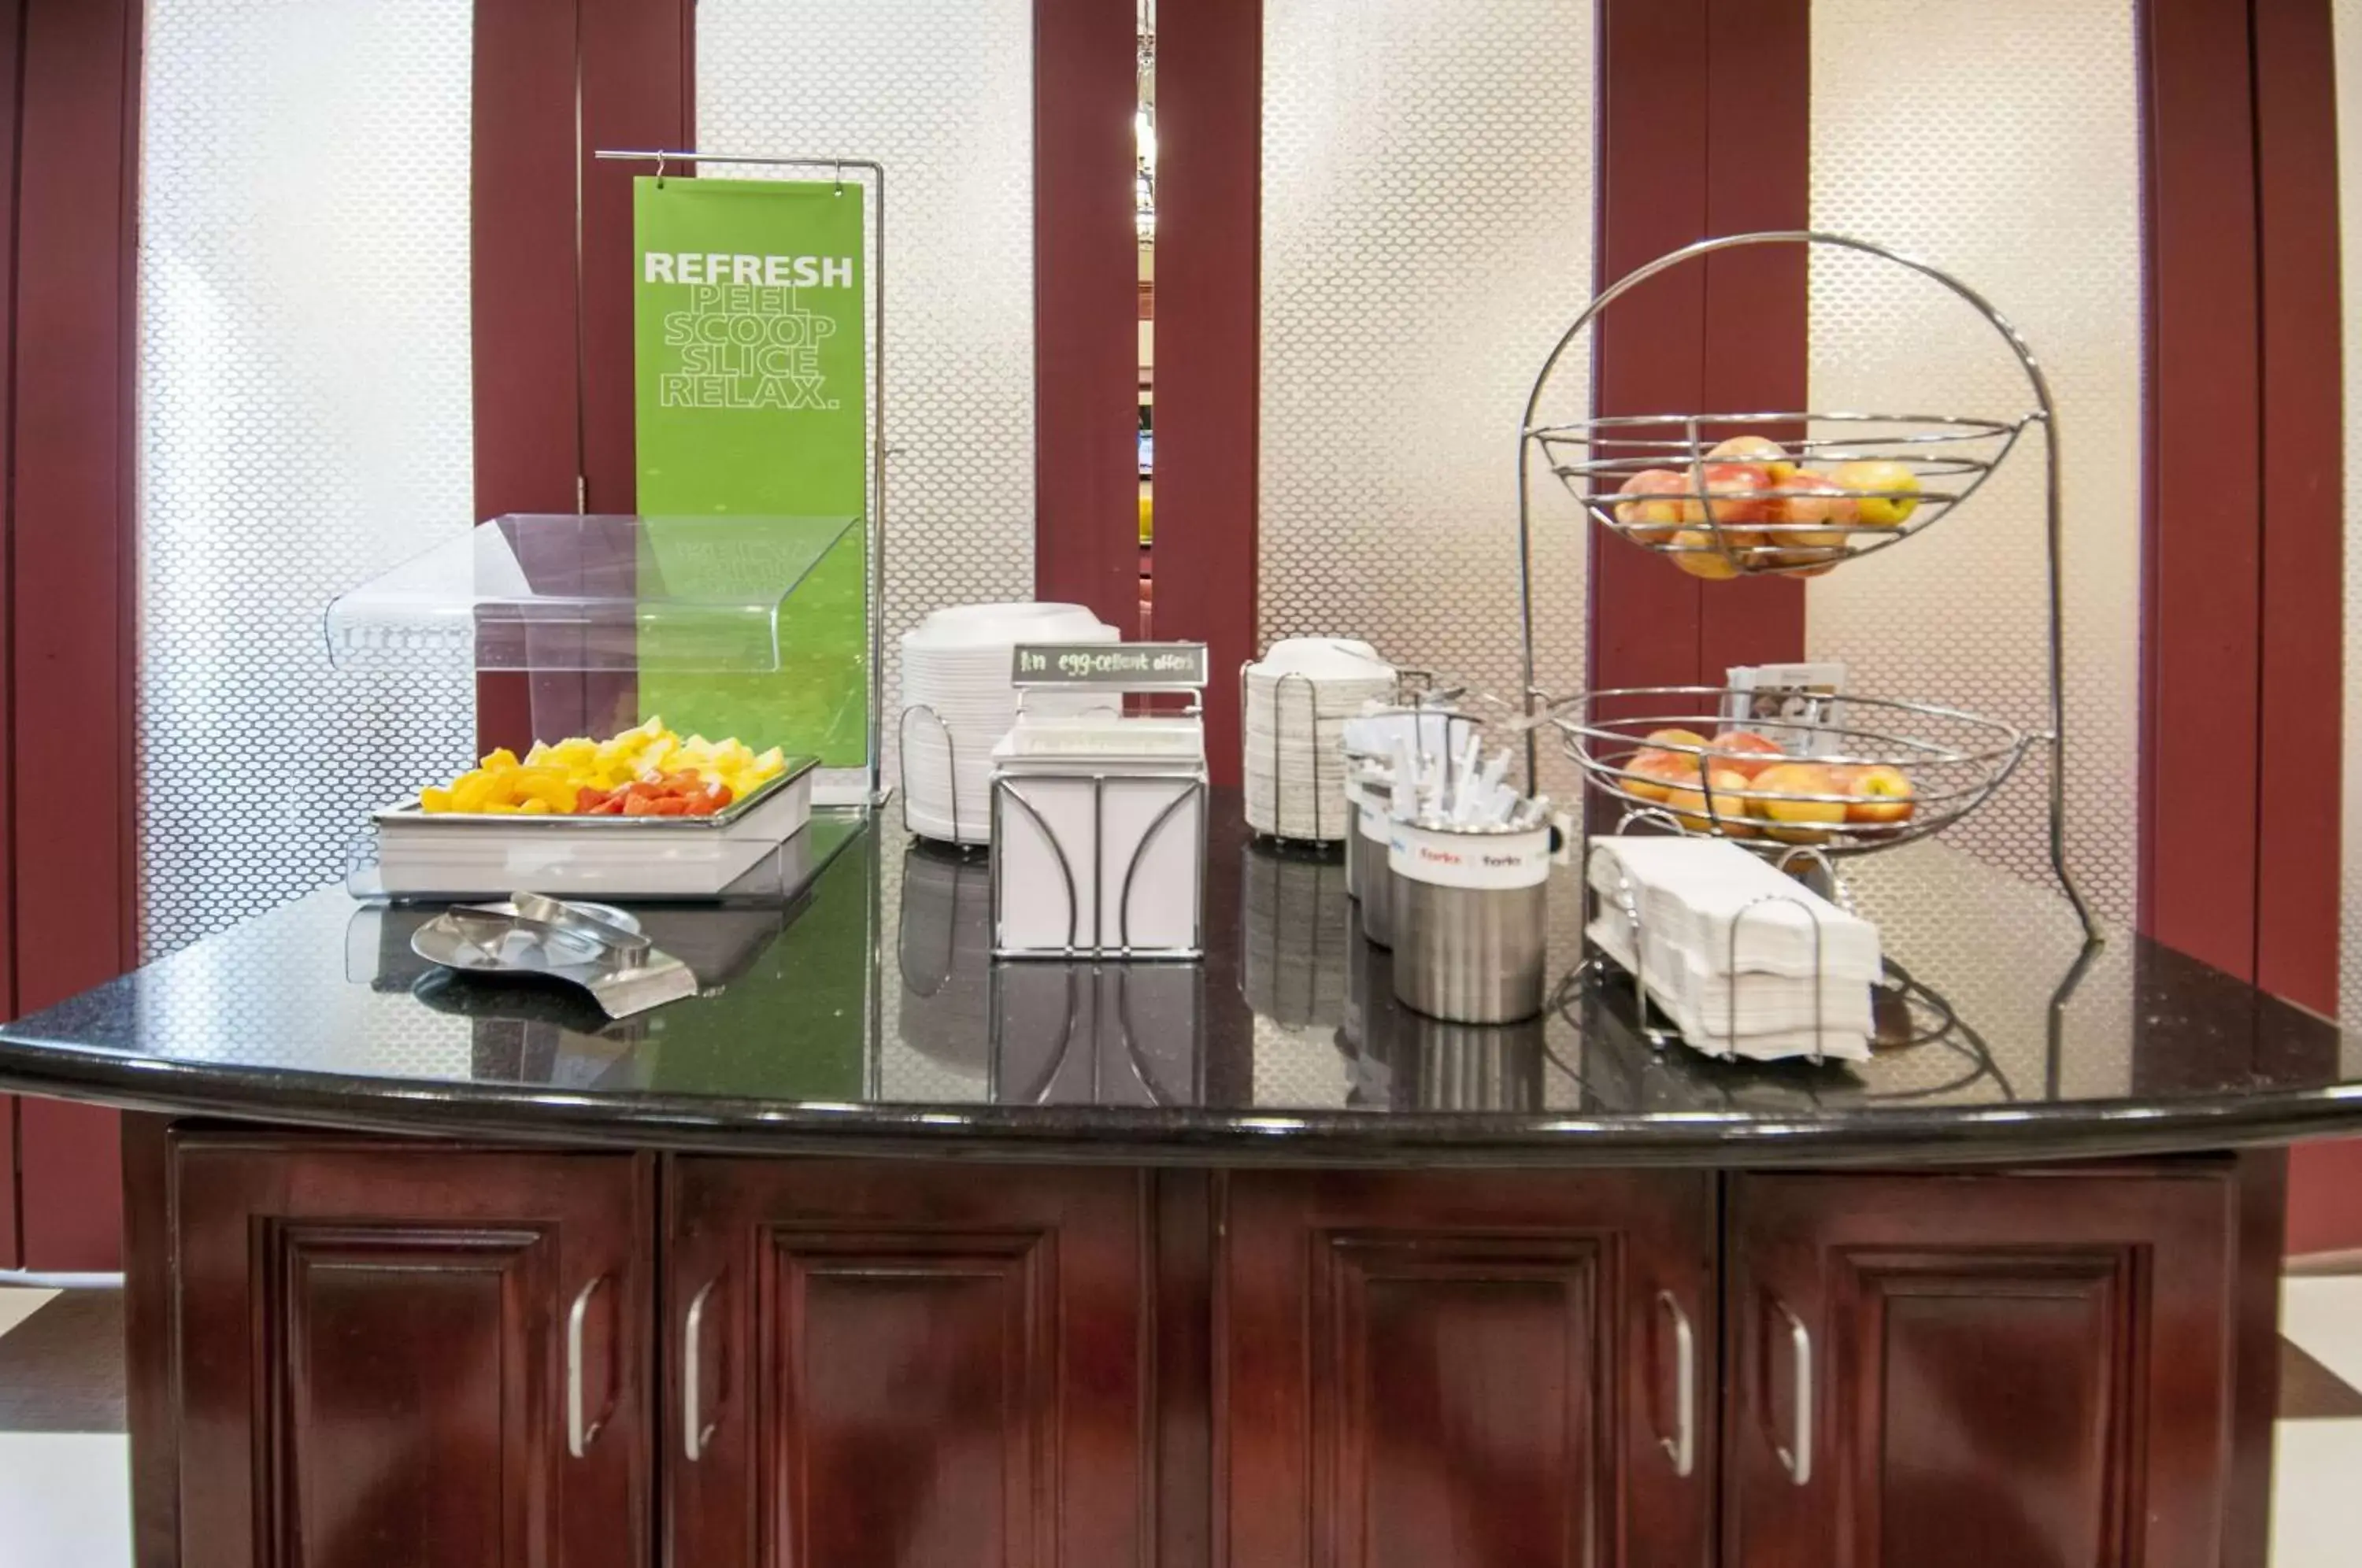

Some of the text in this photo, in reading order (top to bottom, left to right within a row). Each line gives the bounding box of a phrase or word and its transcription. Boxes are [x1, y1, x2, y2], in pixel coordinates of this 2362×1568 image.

[645, 252, 853, 288] REFRESH
[690, 283, 810, 316] PEEL
[664, 312, 837, 348] SCOOP
[681, 343, 820, 379] SLICE
[660, 373, 840, 409] RELAX.
